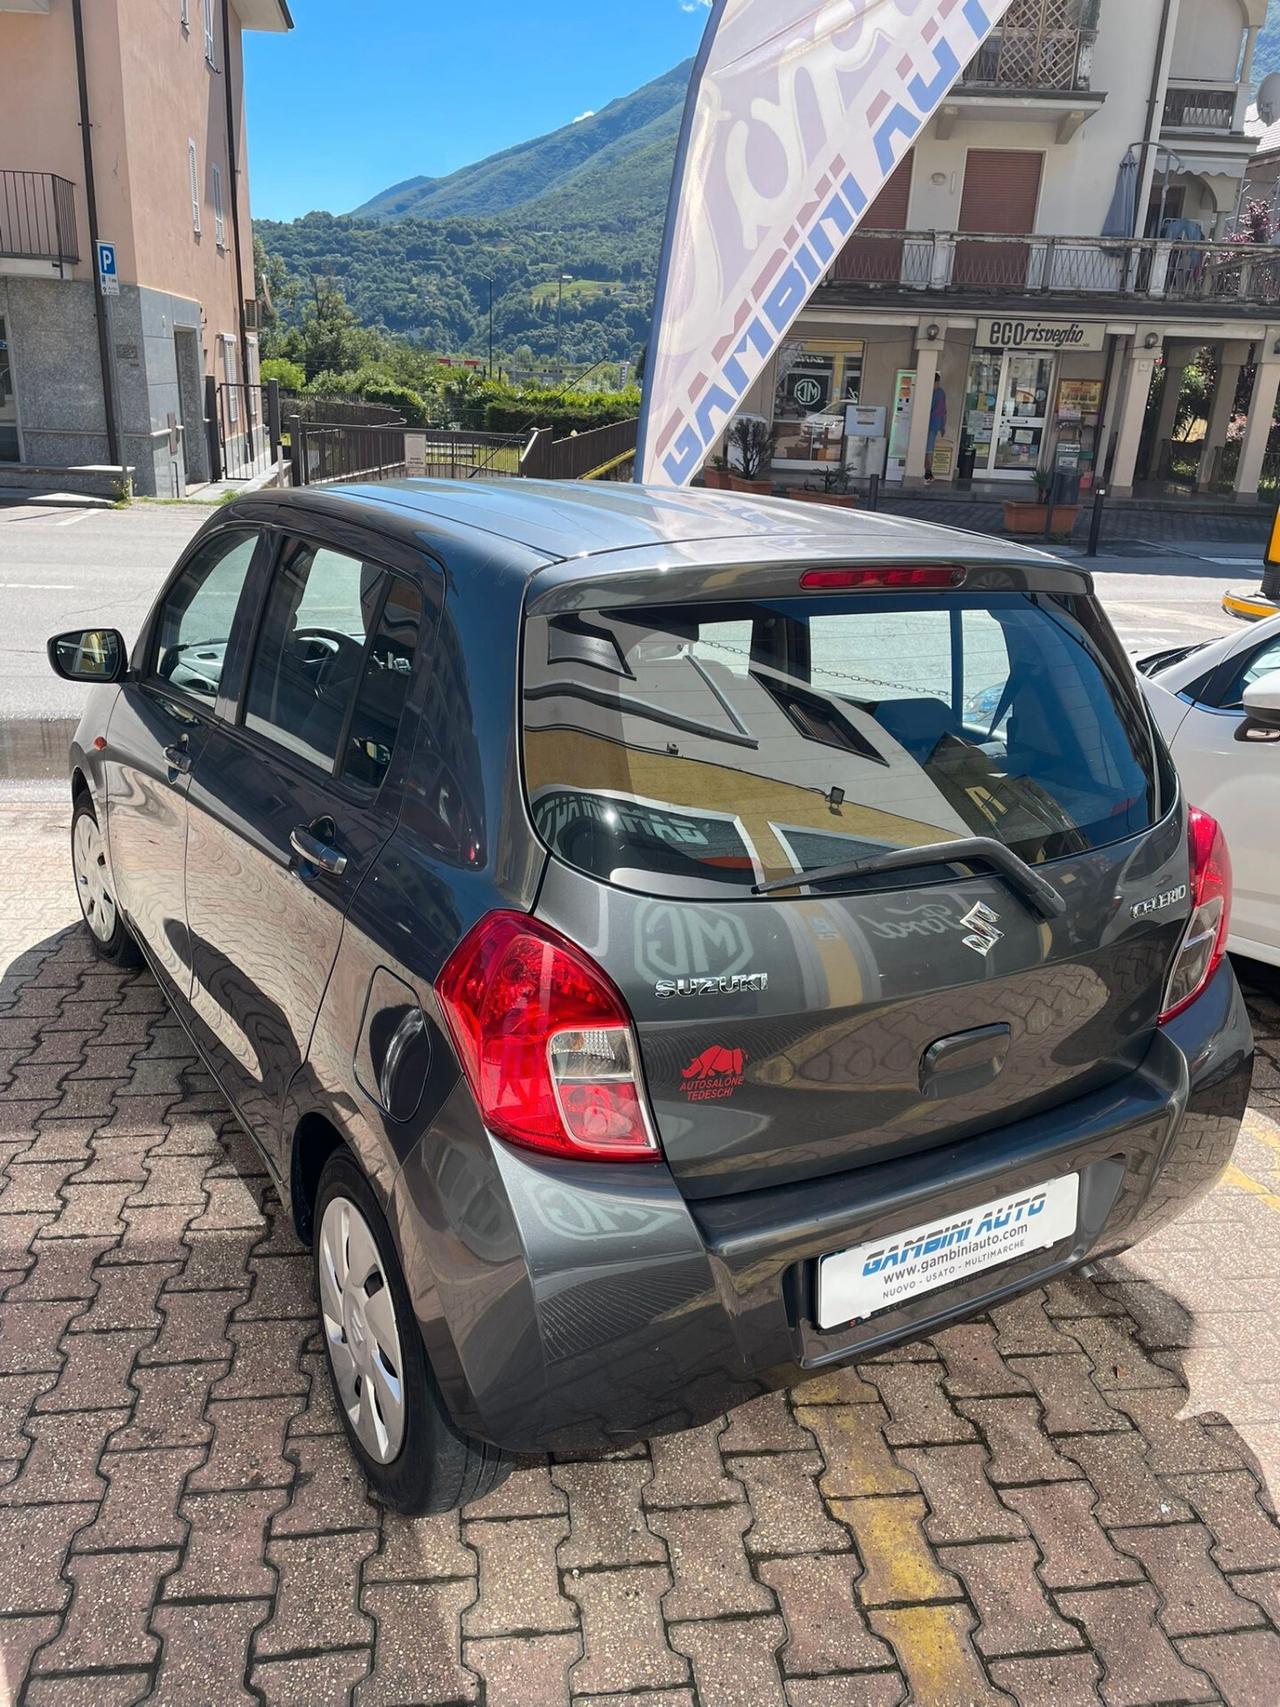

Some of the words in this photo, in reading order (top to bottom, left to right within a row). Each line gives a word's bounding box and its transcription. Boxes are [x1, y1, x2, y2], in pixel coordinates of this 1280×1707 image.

[102, 250, 112, 271] P
[656, 152, 869, 487] GAMBINI
[1130, 885, 1186, 918] CELERIO
[655, 973, 768, 999] SUZUKI
[679, 1075, 744, 1091] AUTOSALONE
[687, 1087, 734, 1100] TEDESCHI
[862, 1218, 974, 1277] GAMBINI
[975, 1192, 1047, 1237] AUTO
[883, 1223, 1028, 1285] www.gambiniauto.com
[883, 1280, 916, 1300] NUOVO
[926, 1265, 955, 1284] USATO
[964, 1239, 1026, 1269] MULTIMARCHE
